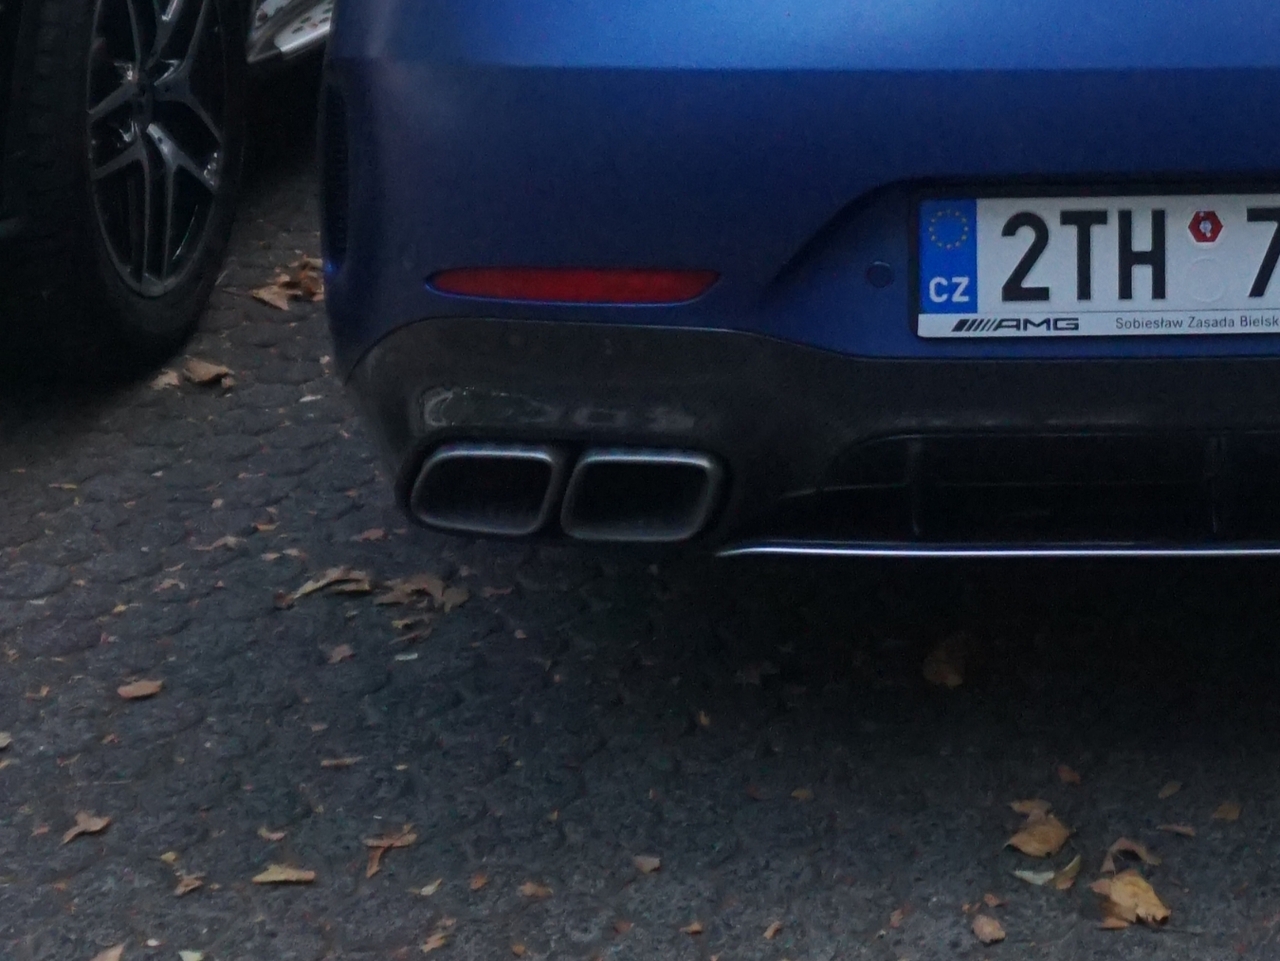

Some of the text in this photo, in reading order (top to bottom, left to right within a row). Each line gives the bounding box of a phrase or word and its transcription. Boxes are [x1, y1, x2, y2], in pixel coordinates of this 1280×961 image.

[1001, 209, 1167, 303] 2TH
[928, 276, 971, 304] CZ
[993, 317, 1080, 332] AMG
[1115, 316, 1184, 330] Sobiesław
[1187, 315, 1235, 329] Zasada
